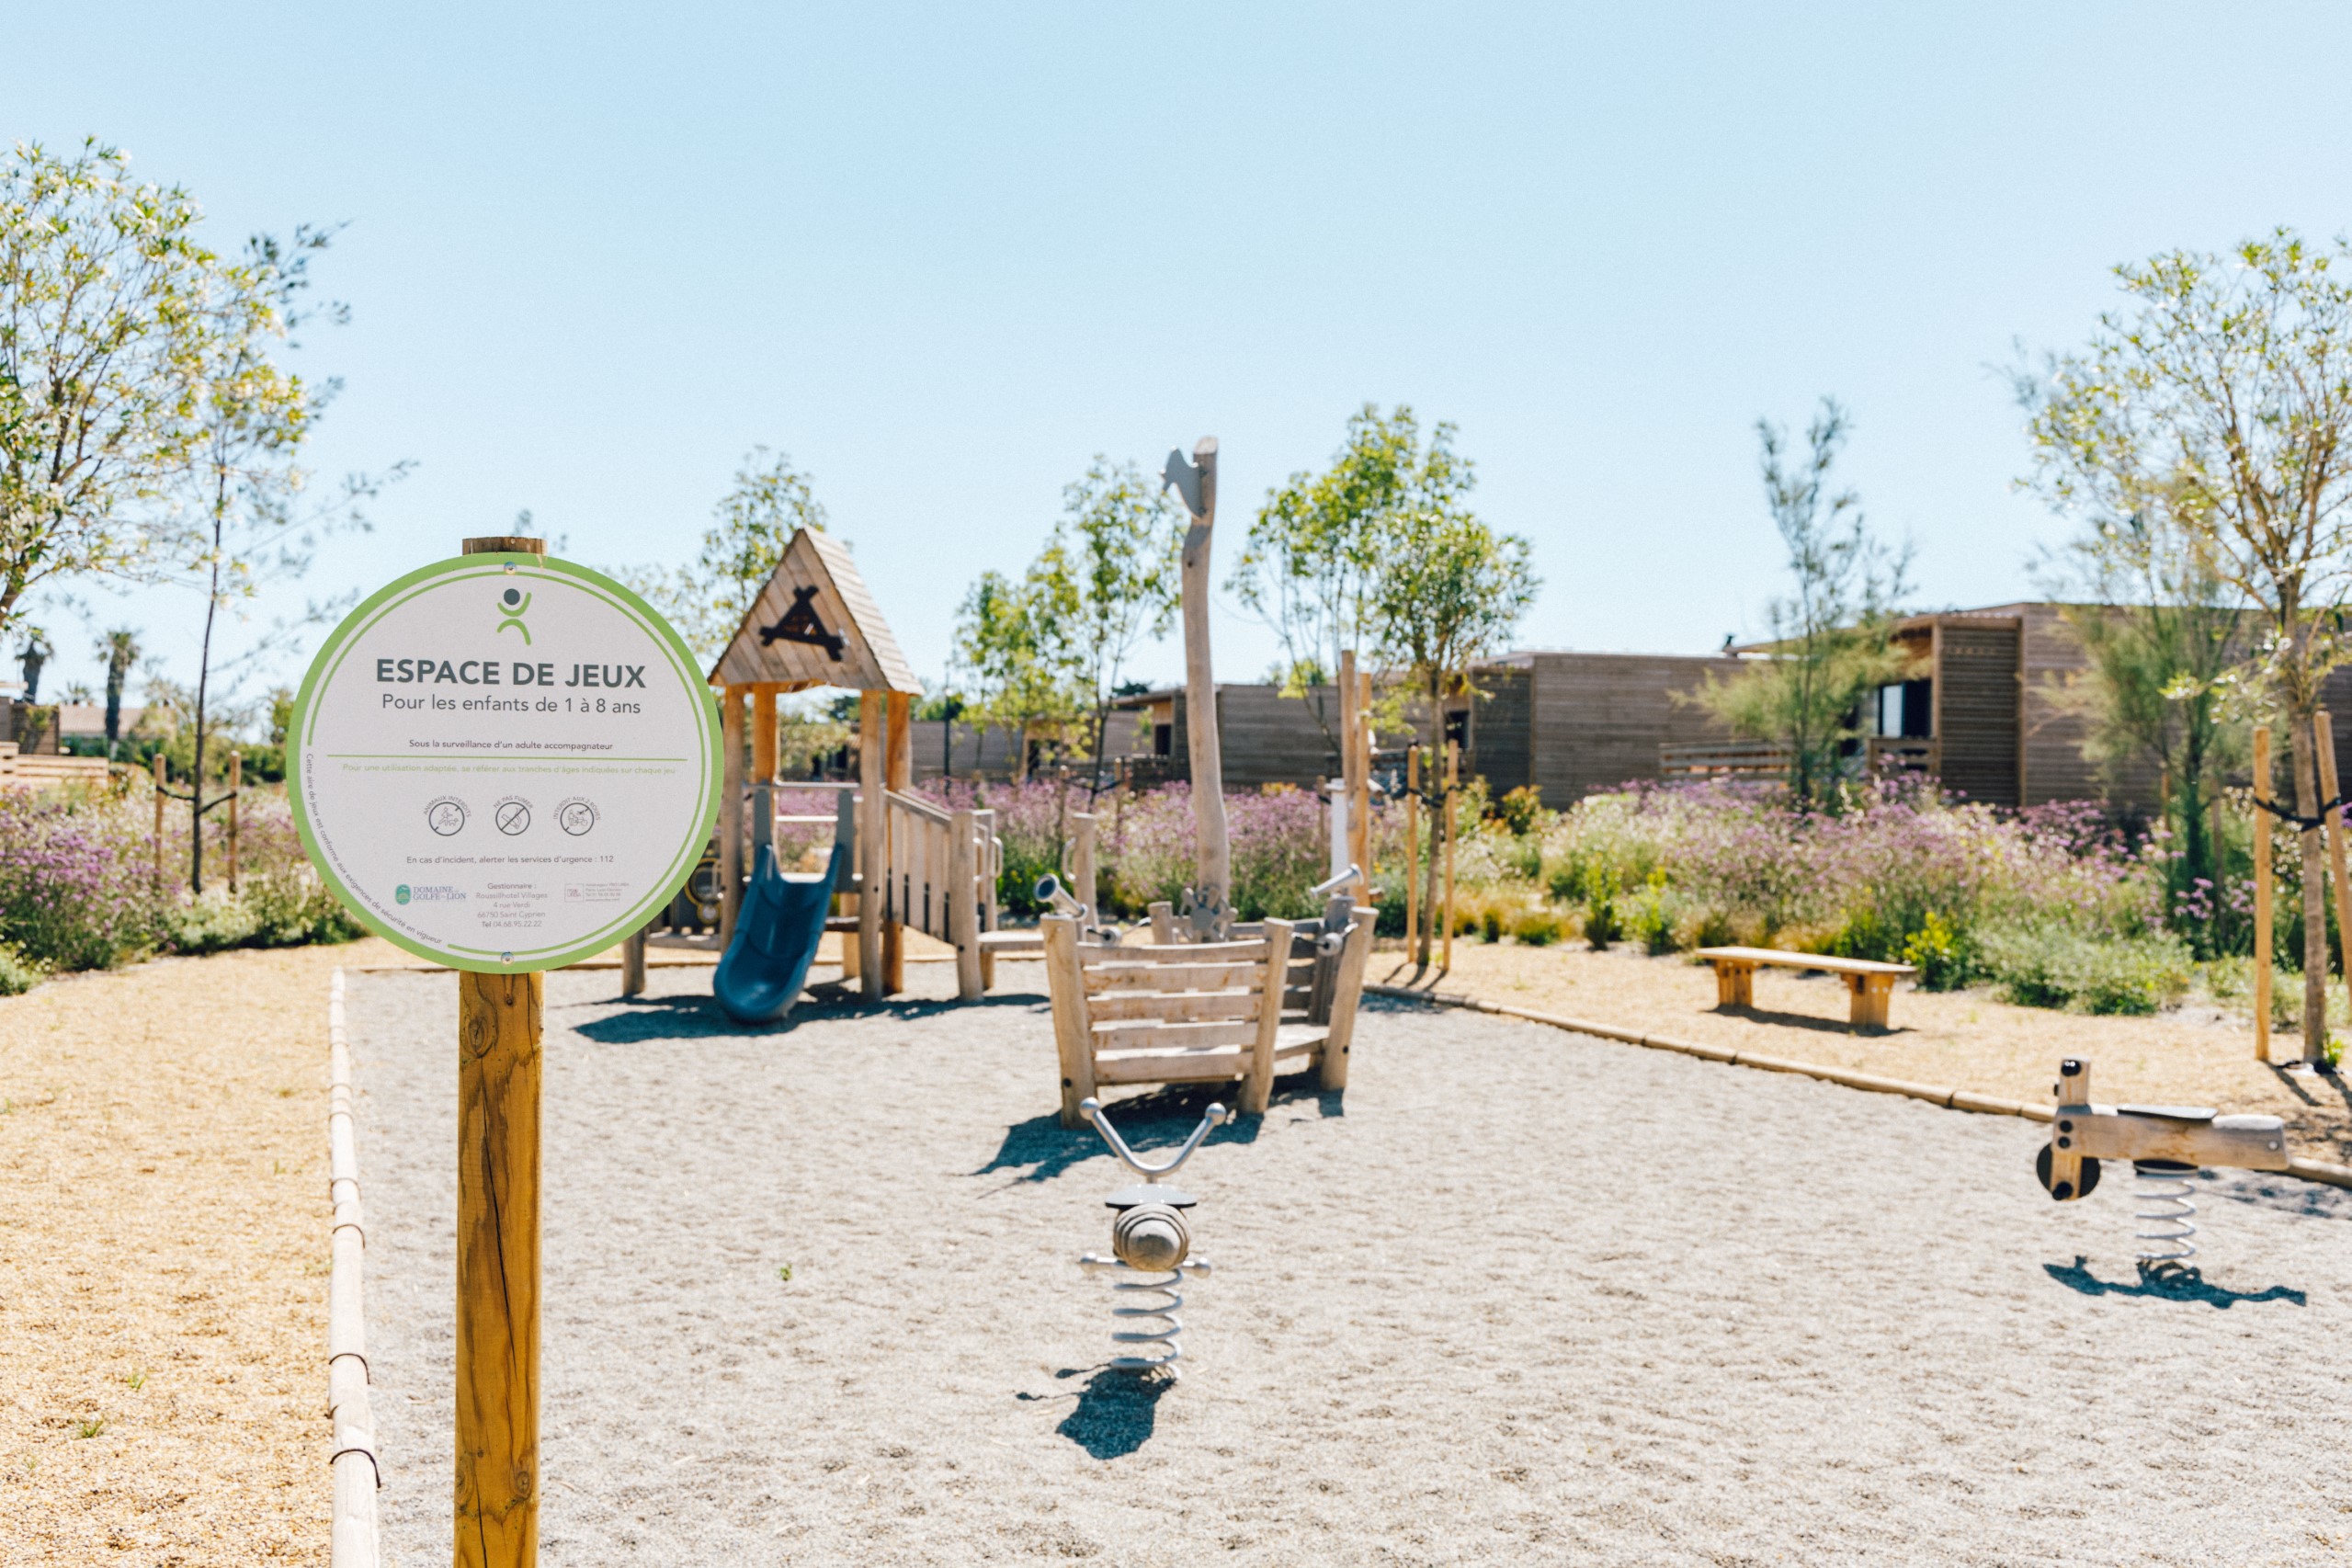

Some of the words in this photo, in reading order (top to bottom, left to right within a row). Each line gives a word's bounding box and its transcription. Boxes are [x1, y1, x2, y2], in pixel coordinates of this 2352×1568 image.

[376, 658, 500, 685] ESPACE
[512, 662, 554, 687] DE
[565, 664, 646, 688] JEUX
[382, 693, 425, 710] Pour
[432, 694, 456, 710] les
[462, 695, 529, 712] enfants
[535, 696, 558, 712] de
[564, 698, 572, 712] 1
[580, 698, 590, 713] à
[596, 699, 607, 713] 8
[612, 701, 641, 713] ans
[409, 739, 430, 748] Sous
[432, 739, 440, 748] la
[442, 740, 492, 749] surveillance
[494, 740, 513, 749] d'un
[515, 741, 541, 750] adulte
[544, 742, 613, 752] accompagnateur
[305, 753, 313, 774] Cette
[382, 764, 421, 772] utilisation
[582, 767, 619, 775] indiquées
[634, 767, 662, 775] chaque
[664, 767, 676, 776] jeu
[309, 790, 315, 801] de
[502, 795, 514, 803] PAS
[514, 795, 534, 810] FUMER
[309, 801, 320, 817] jeux
[423, 794, 448, 815] ANIMAUX
[552, 797, 572, 820] INTERDIT
[315, 817, 324, 829] est
[319, 829, 339, 862] conforme
[336, 861, 347, 874] aux
[406, 856, 418, 864] En
[479, 855, 506, 864] alerter
[507, 856, 518, 864] les
[520, 855, 551, 864] services
[553, 855, 593, 865] d'urgence
[599, 855, 614, 863] 112
[345, 873, 373, 903] exigences
[371, 901, 381, 911] de
[380, 908, 406, 928] sécurité
[406, 925, 416, 933] en
[415, 929, 443, 945] vigueur
